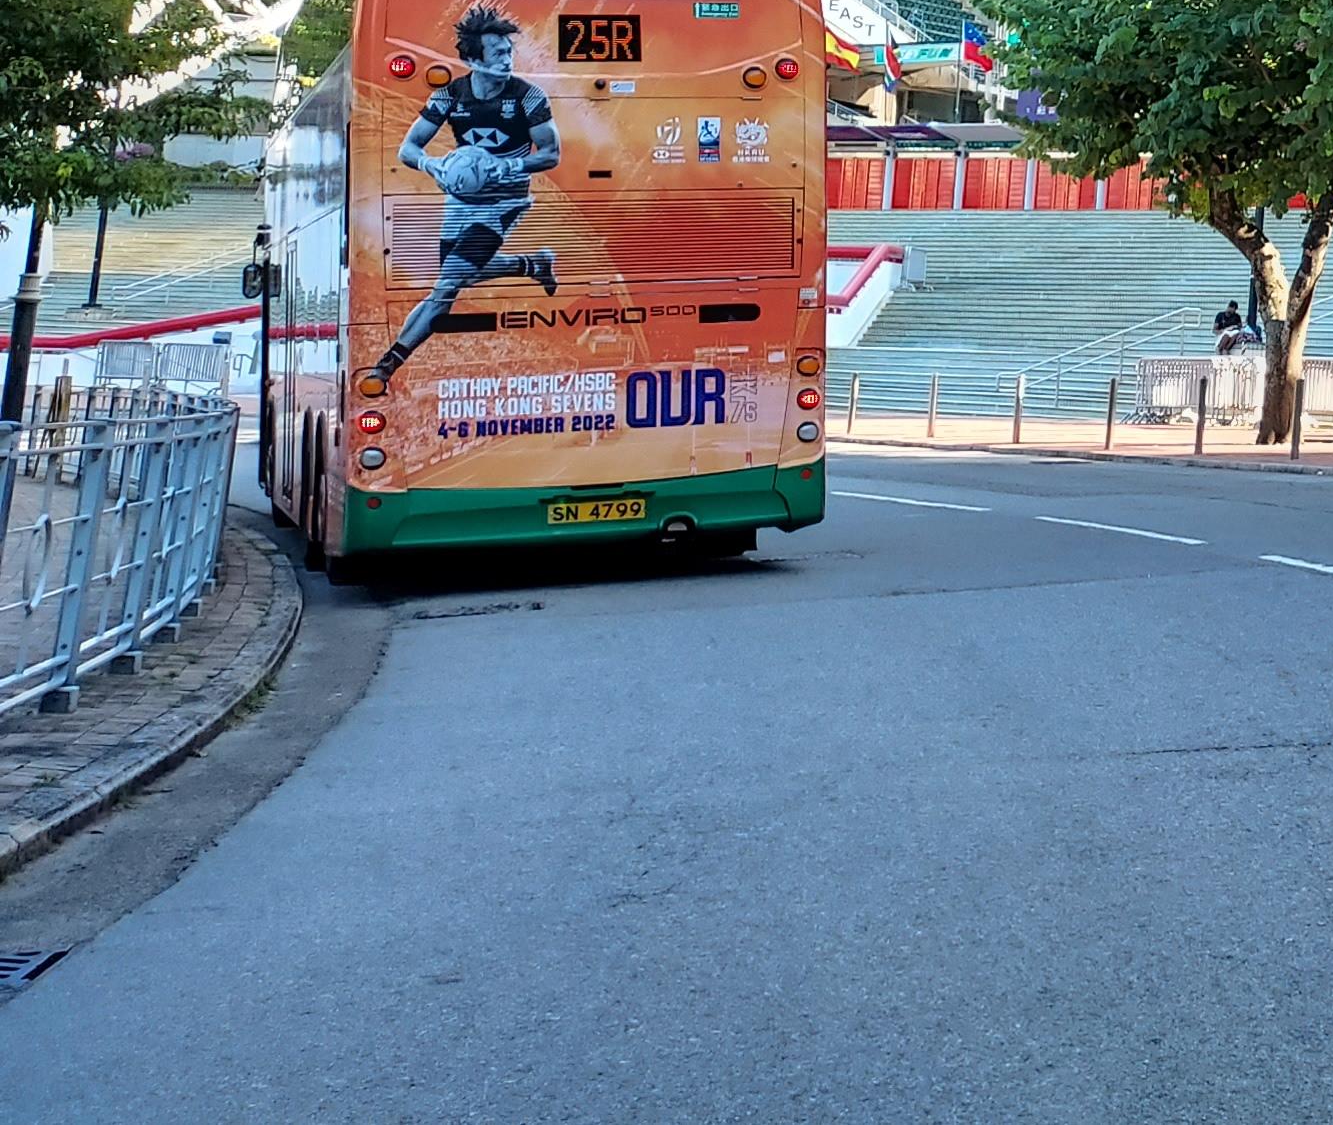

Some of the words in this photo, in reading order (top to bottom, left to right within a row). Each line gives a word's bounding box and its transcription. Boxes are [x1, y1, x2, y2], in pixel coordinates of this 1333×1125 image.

[829, 0, 875, 37] EAST
[565, 20, 633, 59] 25R
[500, 306, 647, 329] ENVIRO
[650, 304, 697, 317] 500
[438, 377, 500, 399] CATHAY
[507, 372, 616, 394] PACIFIC/HSBC
[438, 400, 487, 419] HONG
[495, 397, 543, 416] KONG
[551, 393, 616, 413] SEVENS
[437, 422, 468, 439] 4-6
[475, 417, 565, 437] NOVEMBER
[571, 413, 616, 431] 2022
[553, 505, 579, 521] SN
[589, 501, 642, 519] 4799
